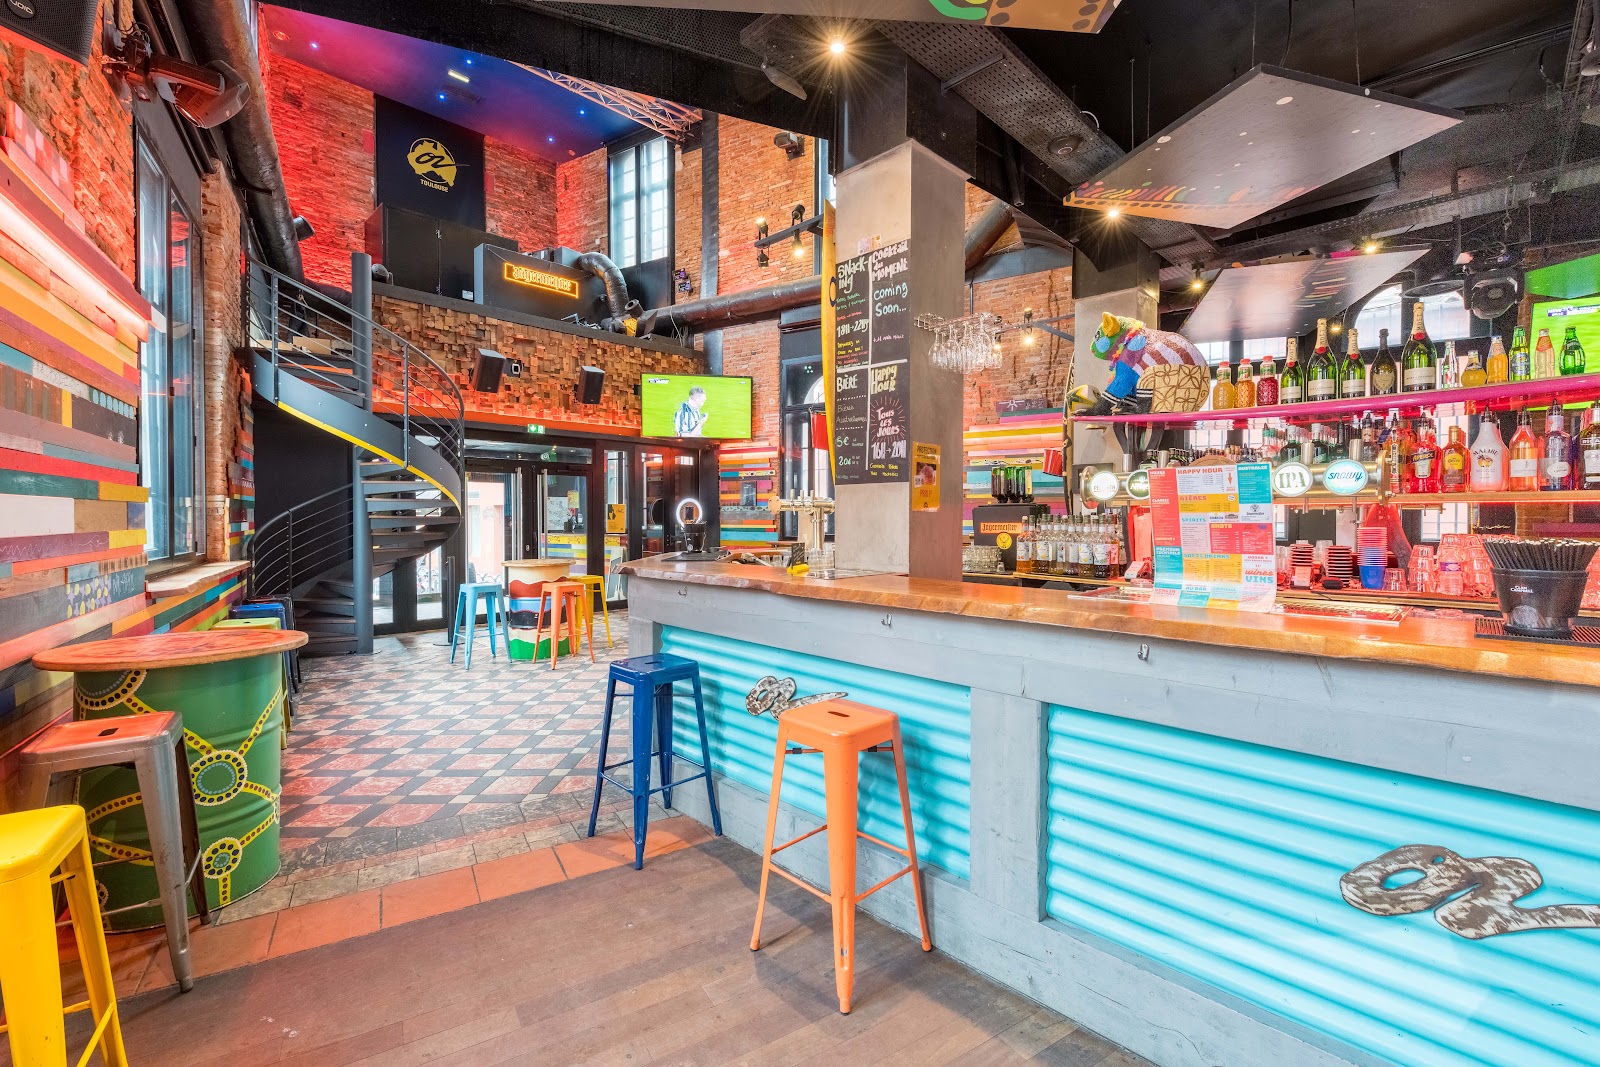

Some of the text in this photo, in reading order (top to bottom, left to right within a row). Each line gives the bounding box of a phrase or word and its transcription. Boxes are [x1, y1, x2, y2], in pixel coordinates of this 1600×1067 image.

[420, 178, 449, 193] TOULOUSE
[1279, 472, 1306, 489] IPA
[1245, 575, 1274, 584] VINS
